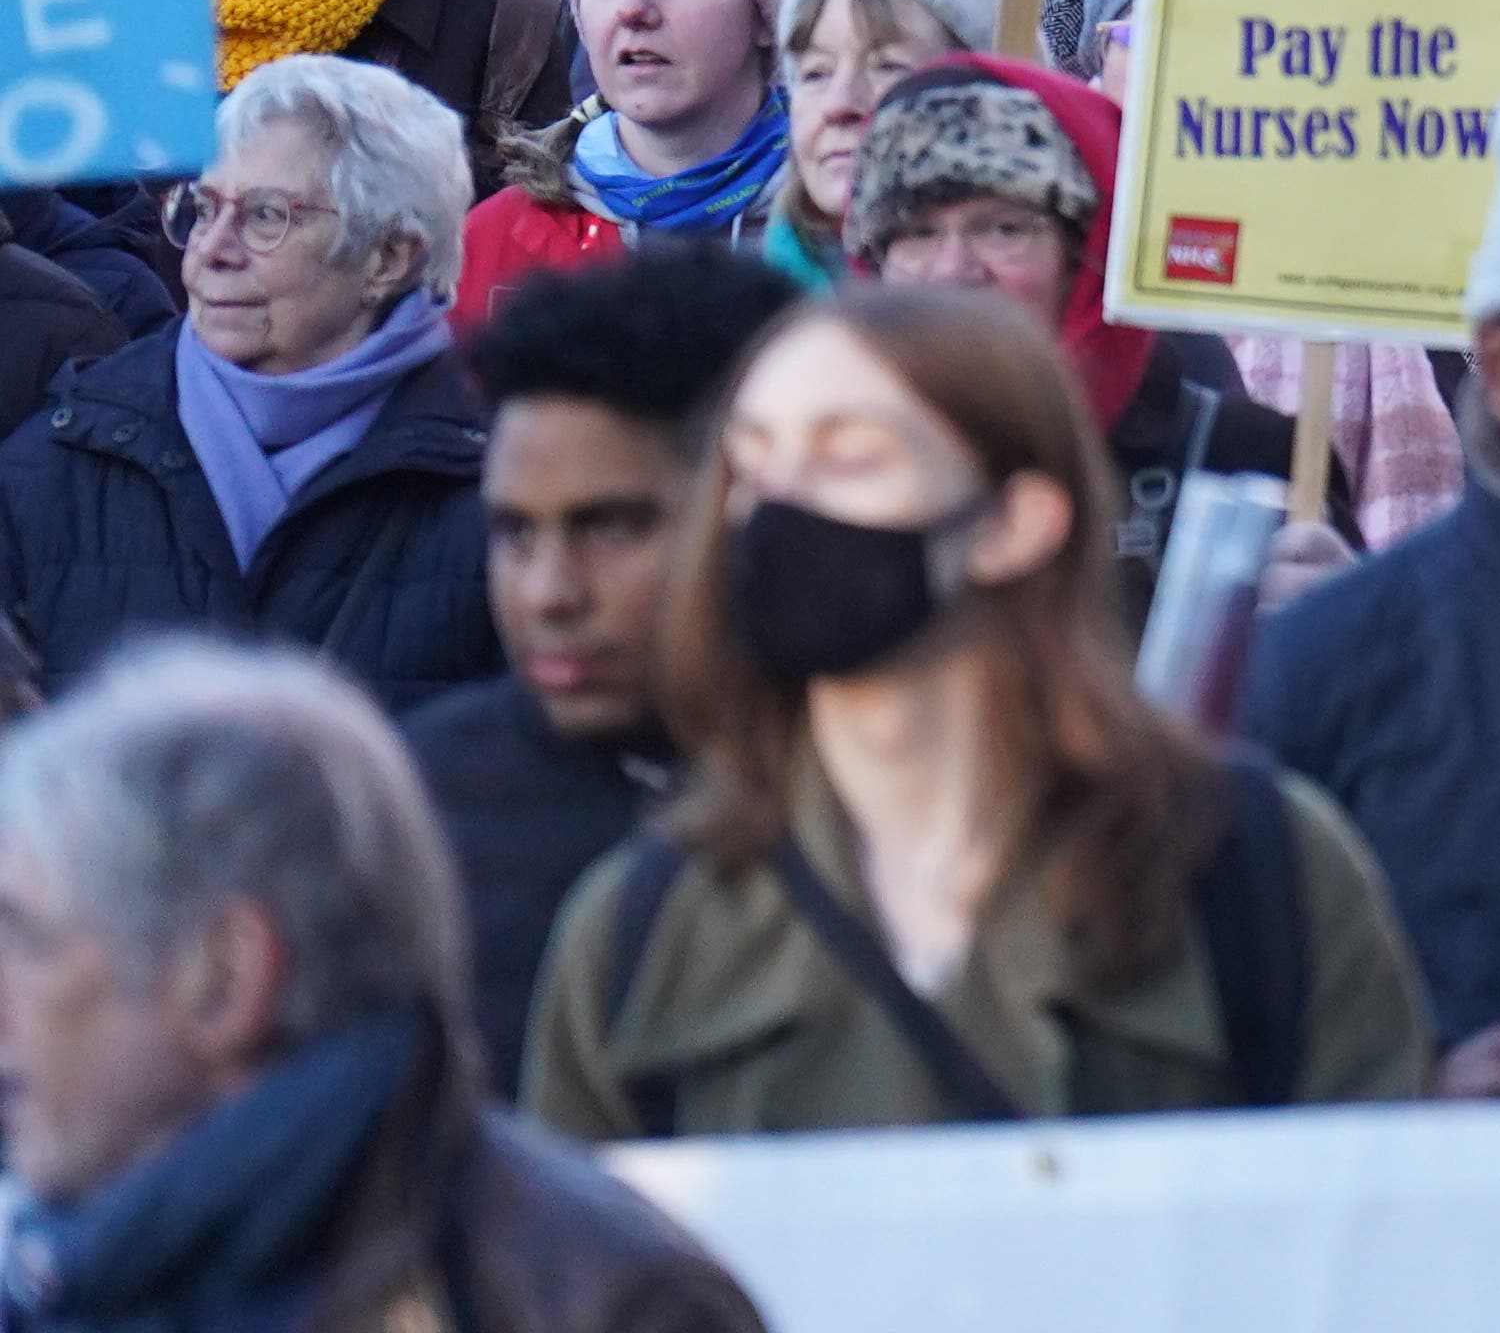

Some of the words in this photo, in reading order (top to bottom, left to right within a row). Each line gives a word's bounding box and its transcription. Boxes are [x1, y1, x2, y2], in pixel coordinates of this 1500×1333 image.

[1238, 16, 1348, 86] Pay
[1367, 17, 1458, 80] the
[1175, 97, 1356, 159] Nurses
[1377, 99, 1496, 159] Now
